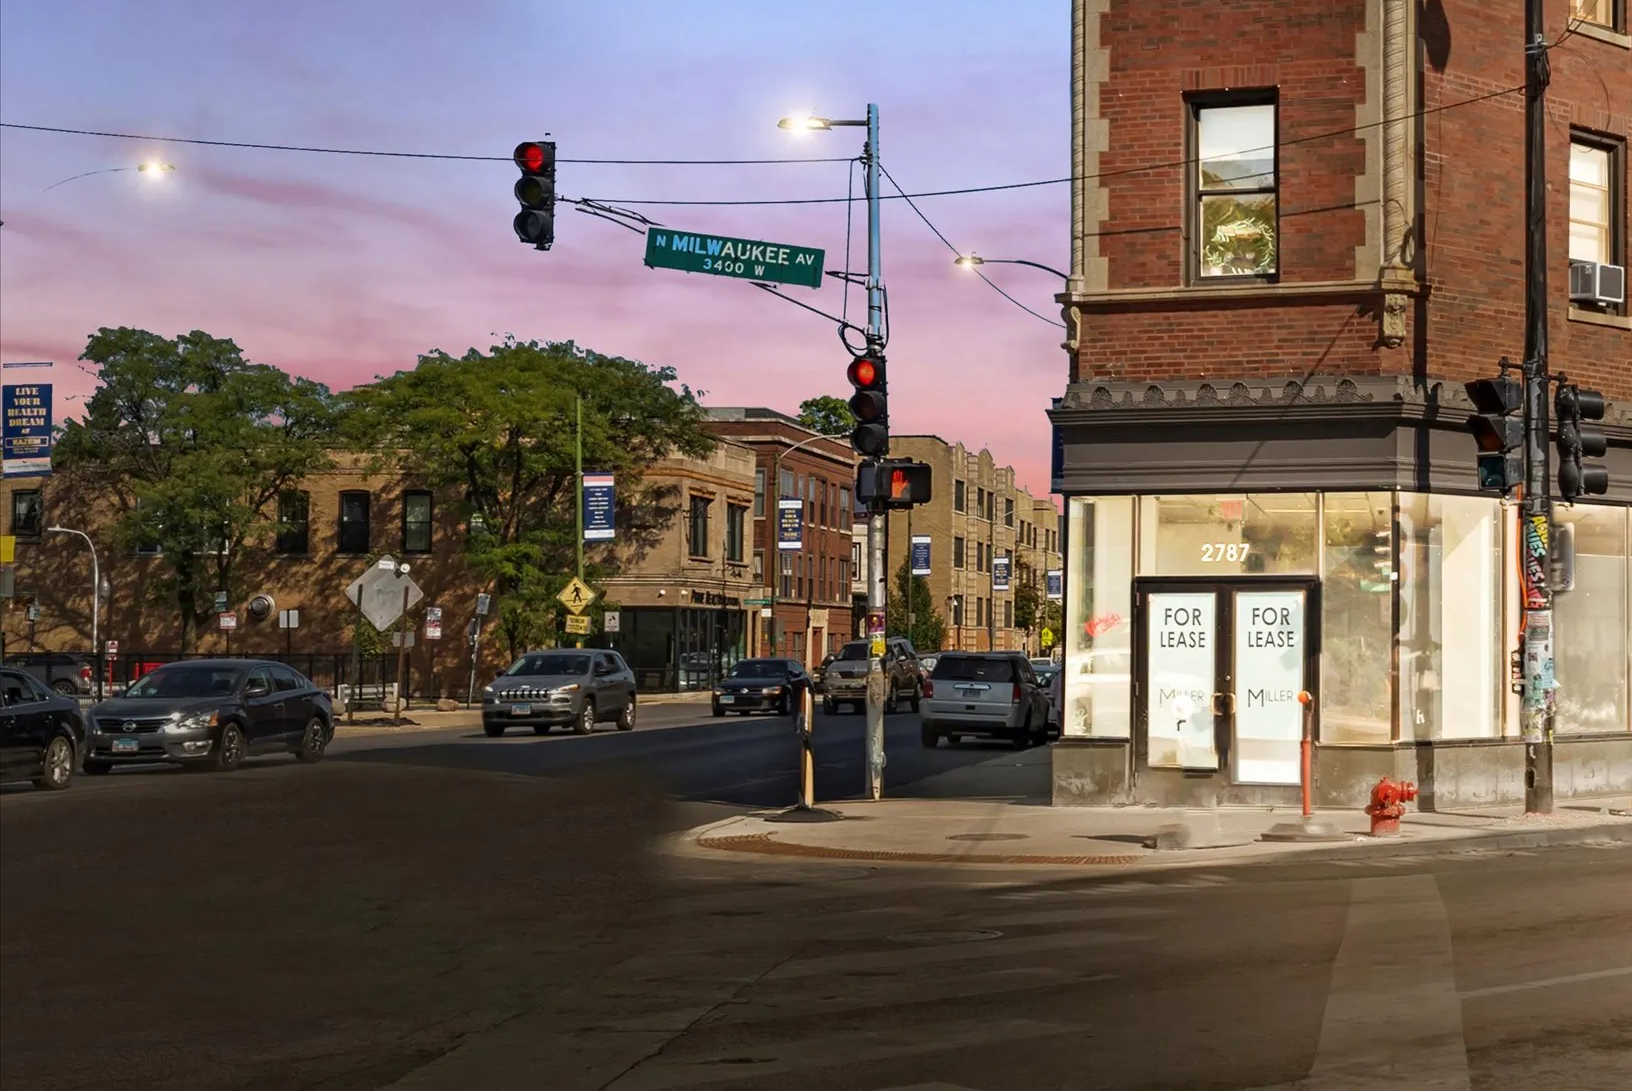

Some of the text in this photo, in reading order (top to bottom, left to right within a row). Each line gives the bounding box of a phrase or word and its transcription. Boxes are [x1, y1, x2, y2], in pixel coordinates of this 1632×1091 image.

[656, 234, 815, 266] N MILWAUKEE AV
[703, 258, 765, 277] 3400 W
[15, 387, 39, 396] LIVE
[14, 397, 41, 406] YOUR
[7, 407, 47, 416] HEALTH
[9, 417, 45, 427] DREAM
[1200, 543, 1250, 562] 2787
[1164, 608, 1202, 626] FOR
[1252, 607, 1290, 626] FOR
[1160, 631, 1206, 648] LEASE
[1248, 631, 1295, 648] LEASE
[1248, 688, 1294, 708] MILLER
